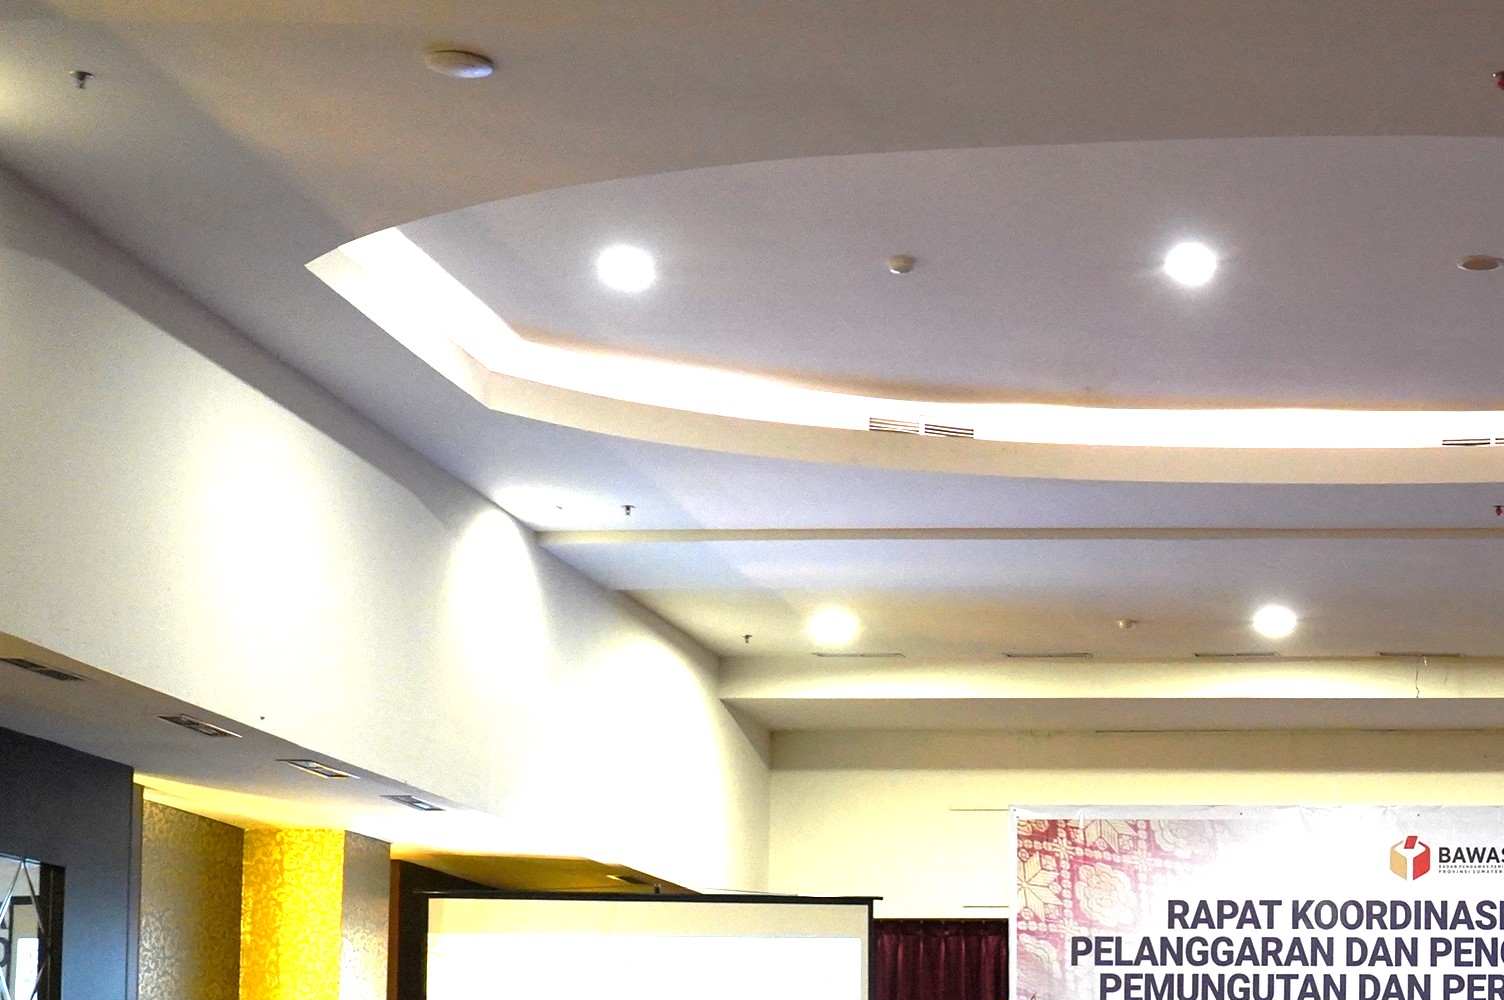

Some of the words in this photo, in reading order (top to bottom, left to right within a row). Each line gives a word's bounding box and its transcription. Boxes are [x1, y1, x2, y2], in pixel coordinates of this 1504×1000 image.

[1168, 900, 1282, 930] RAPAT
[1071, 936, 1334, 967] PELANGGARAN
[1346, 937, 1418, 967] DAN
